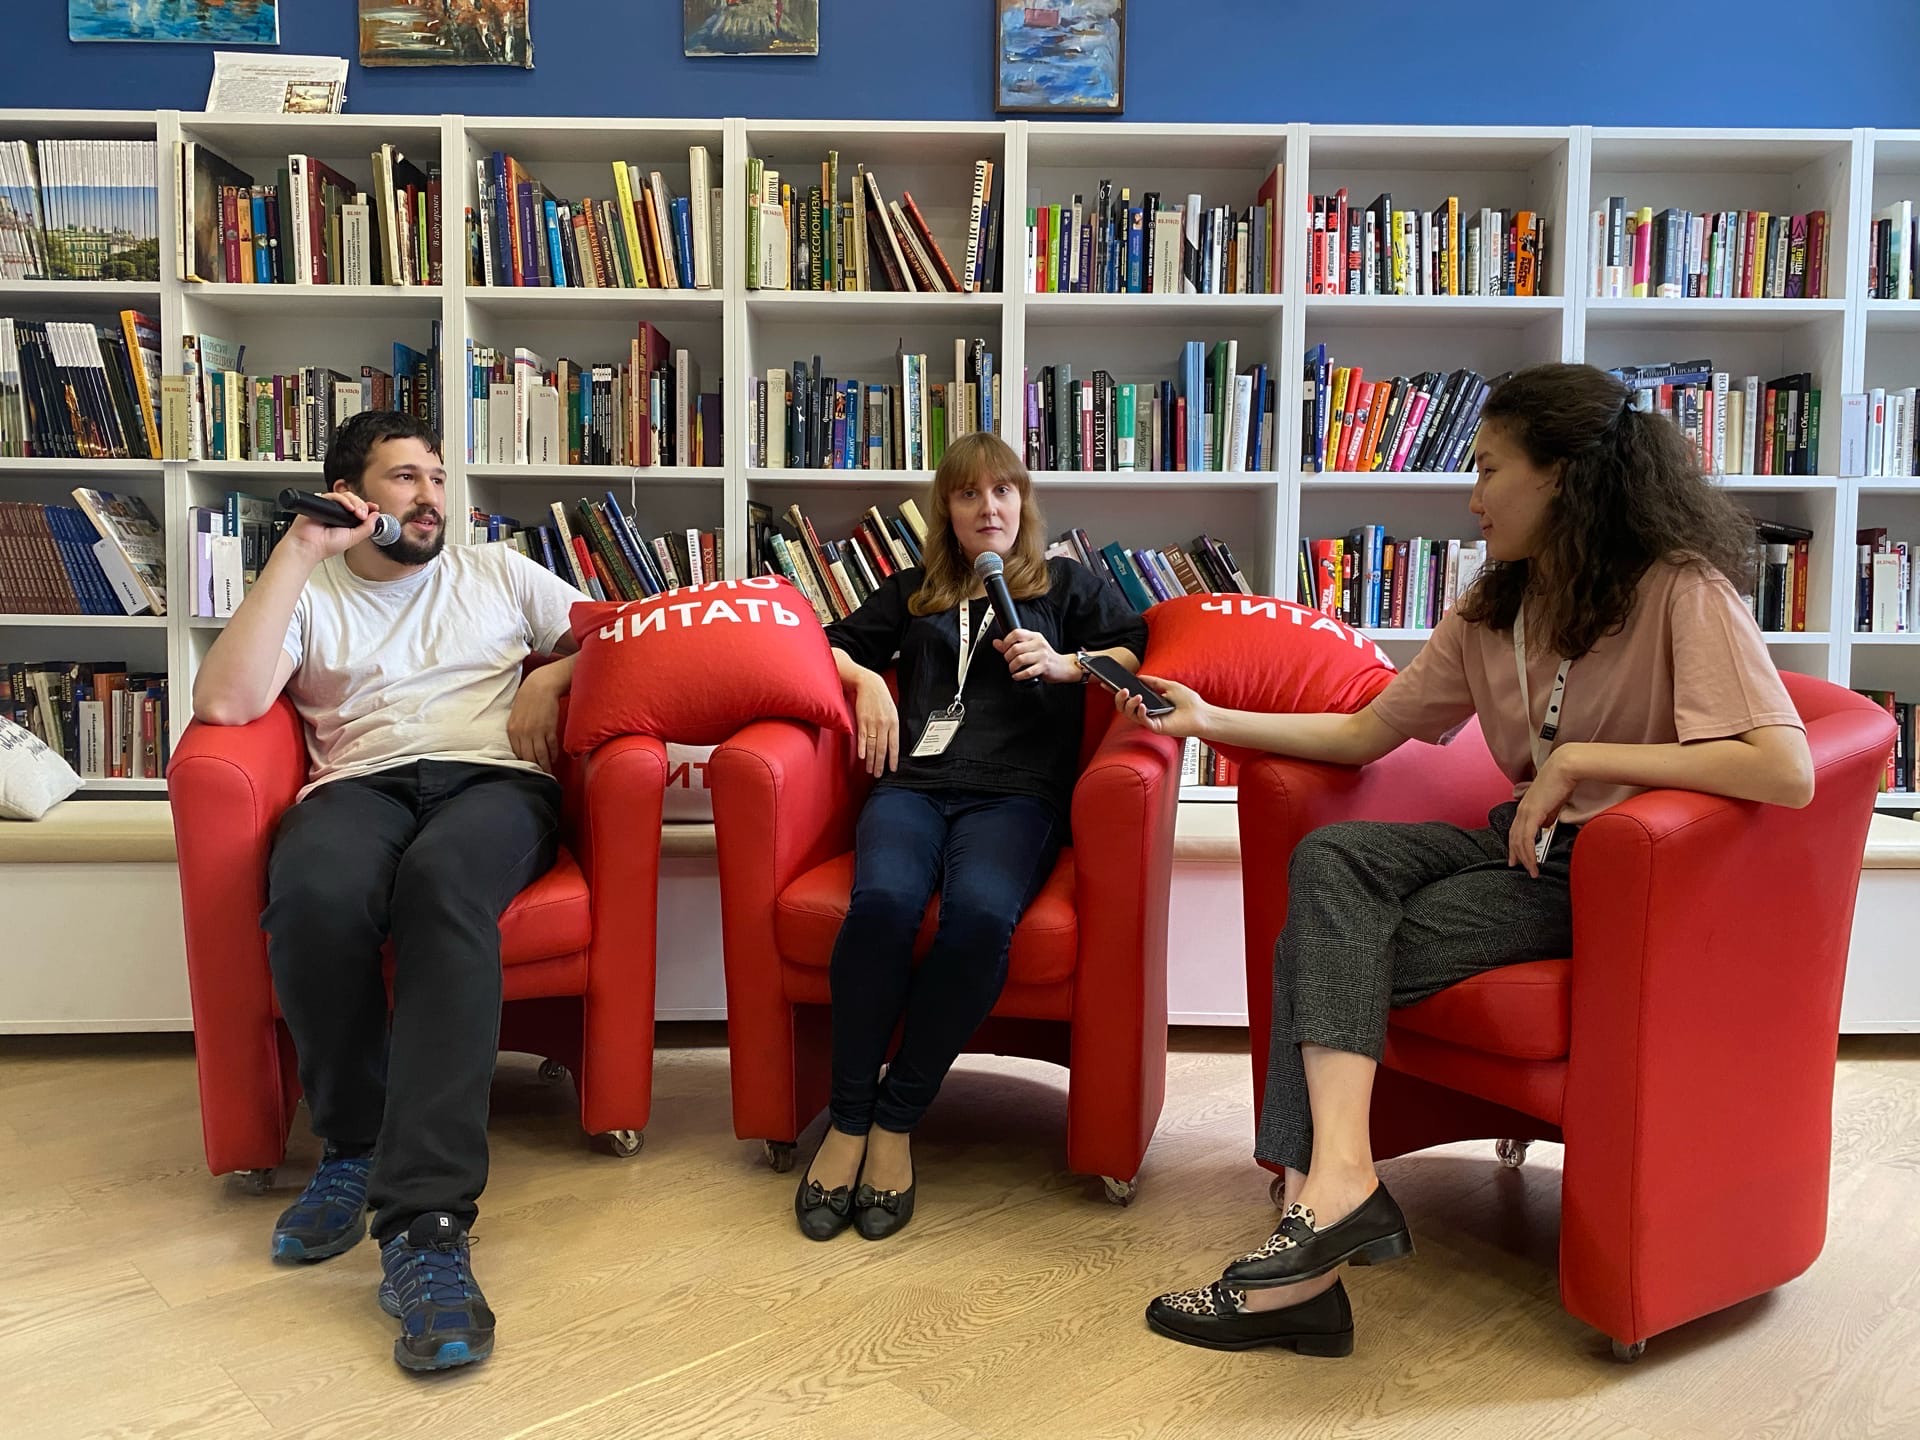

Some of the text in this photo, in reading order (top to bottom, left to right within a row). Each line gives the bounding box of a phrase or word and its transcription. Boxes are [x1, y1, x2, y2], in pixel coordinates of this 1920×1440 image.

[799, 202, 807, 240] ПОРТРЕТЫ
[811, 190, 821, 290] ИМПРЕССИОНИЗМ
[1329, 212, 1337, 230] РОК
[1351, 226, 1360, 251] МУЗЫКЕ
[964, 205, 980, 286] ФРАНСИСКО
[1349, 252, 1361, 270] РОК
[1717, 374, 1728, 434] ФУРМАНОВ
[317, 440, 327, 460] Мир
[1095, 411, 1105, 457] РИХТЕР
[1799, 428, 1808, 449] Елена
[599, 598, 800, 643] ЧИТАТЬ
